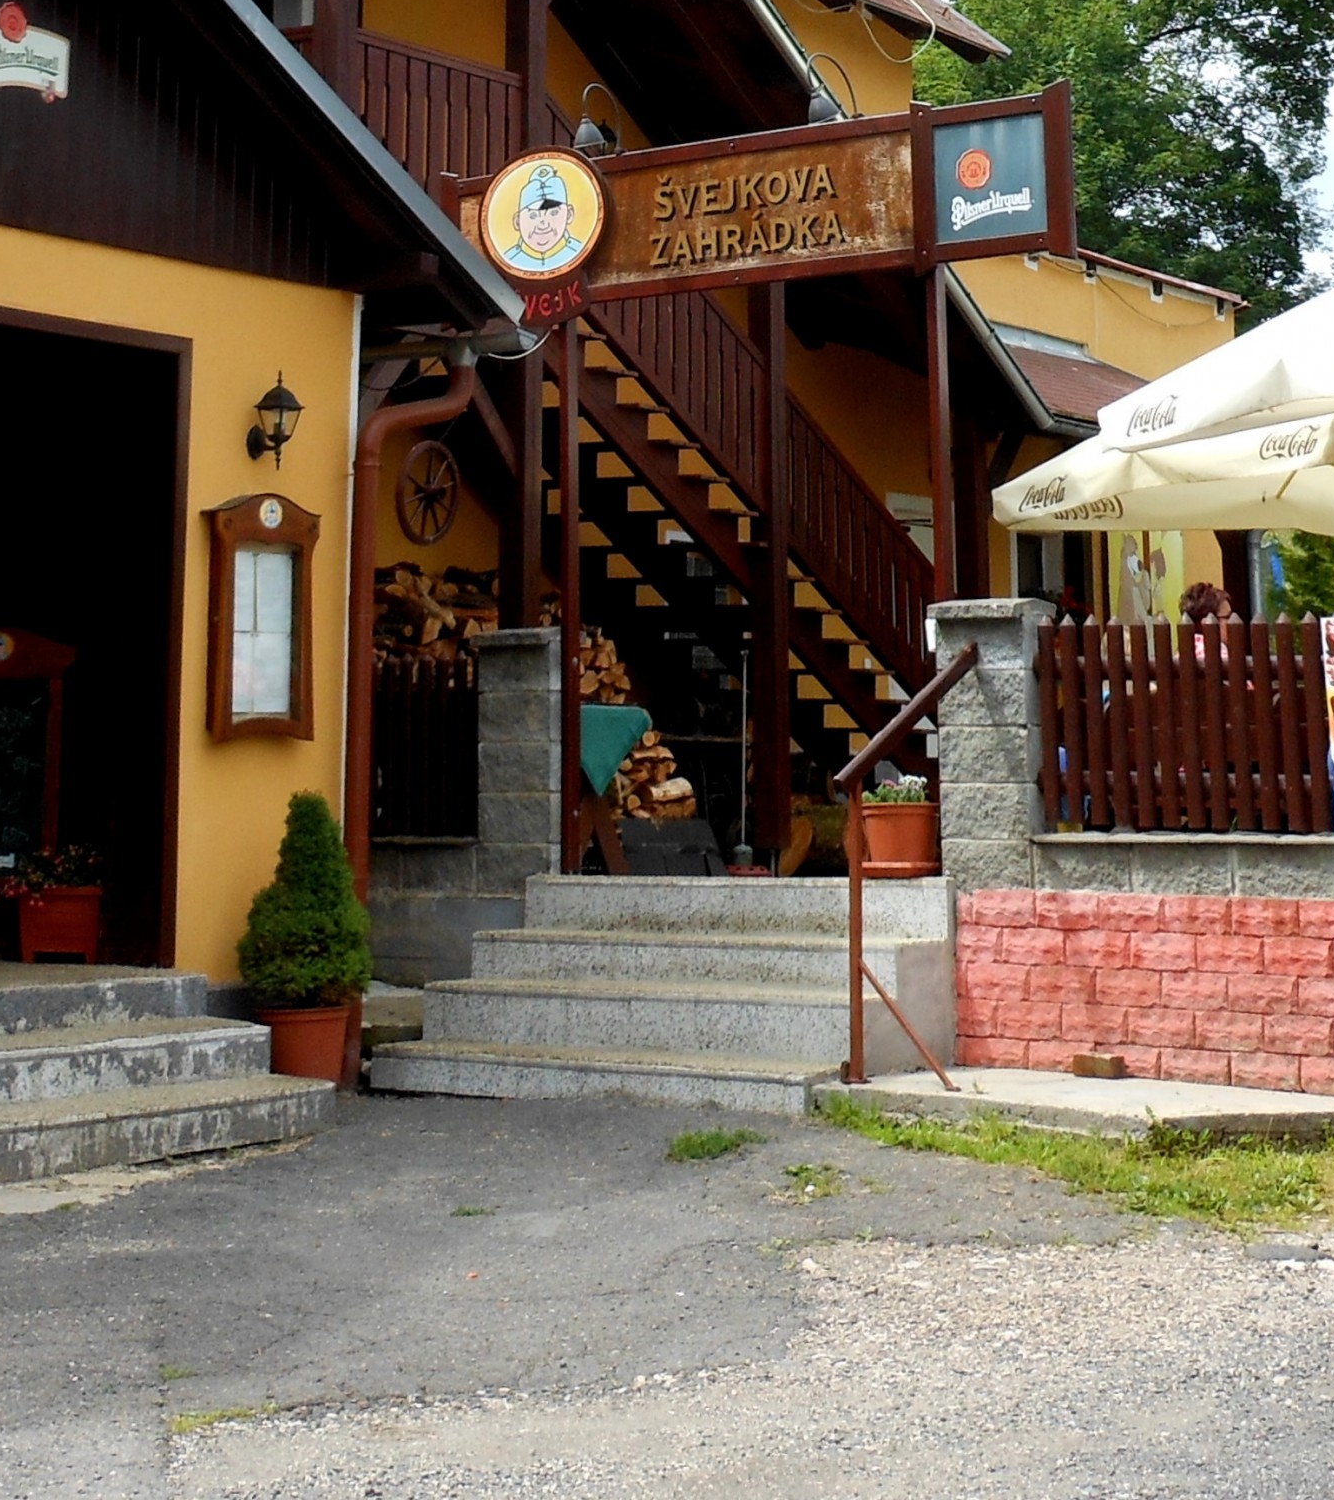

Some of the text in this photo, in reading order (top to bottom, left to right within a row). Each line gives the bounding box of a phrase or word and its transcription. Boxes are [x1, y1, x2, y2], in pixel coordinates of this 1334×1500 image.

[25, 46, 59, 74] Urquell
[652, 164, 837, 220] ŠVEJKOVA
[951, 187, 1030, 231] Pilsner Urquell
[649, 210, 844, 267] ZAHRÁDKA
[524, 280, 582, 320] VEJK
[1126, 395, 1179, 437] Coca-Cola
[1259, 425, 1321, 460] Coca-Cola
[1019, 474, 1068, 512] Coca-Cola
